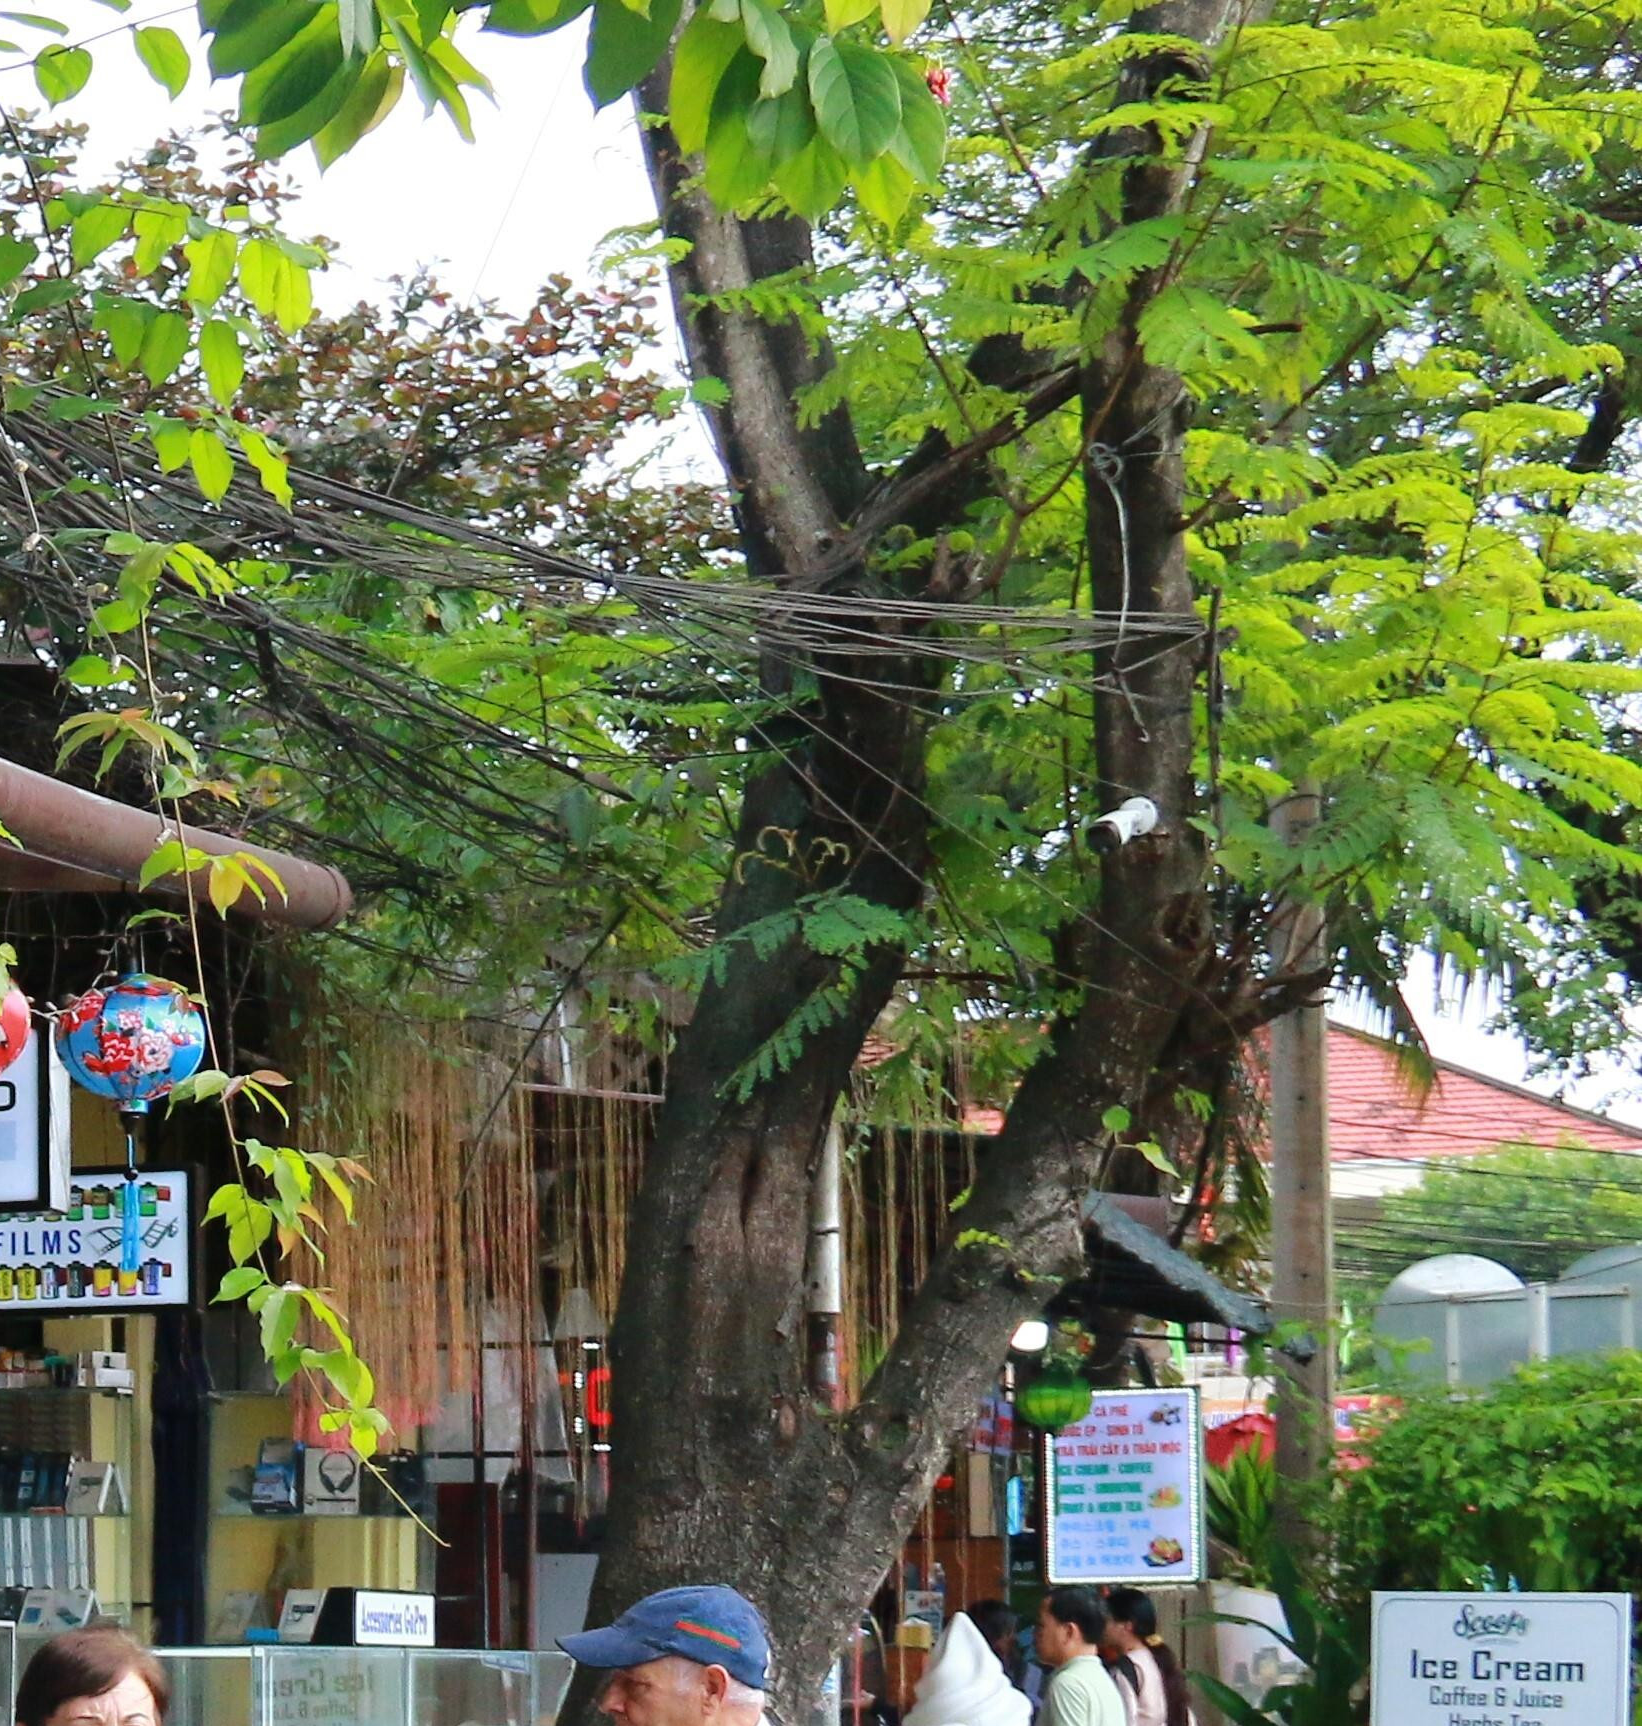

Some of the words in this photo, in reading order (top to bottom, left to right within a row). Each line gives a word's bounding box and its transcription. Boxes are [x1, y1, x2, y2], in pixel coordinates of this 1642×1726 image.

[1410, 1649, 1457, 1679] Ice
[1473, 1650, 1584, 1682] Cream
[1429, 1685, 1487, 1706] Coffee
[1494, 1687, 1506, 1706] &
[1513, 1688, 1564, 1708] Juice
